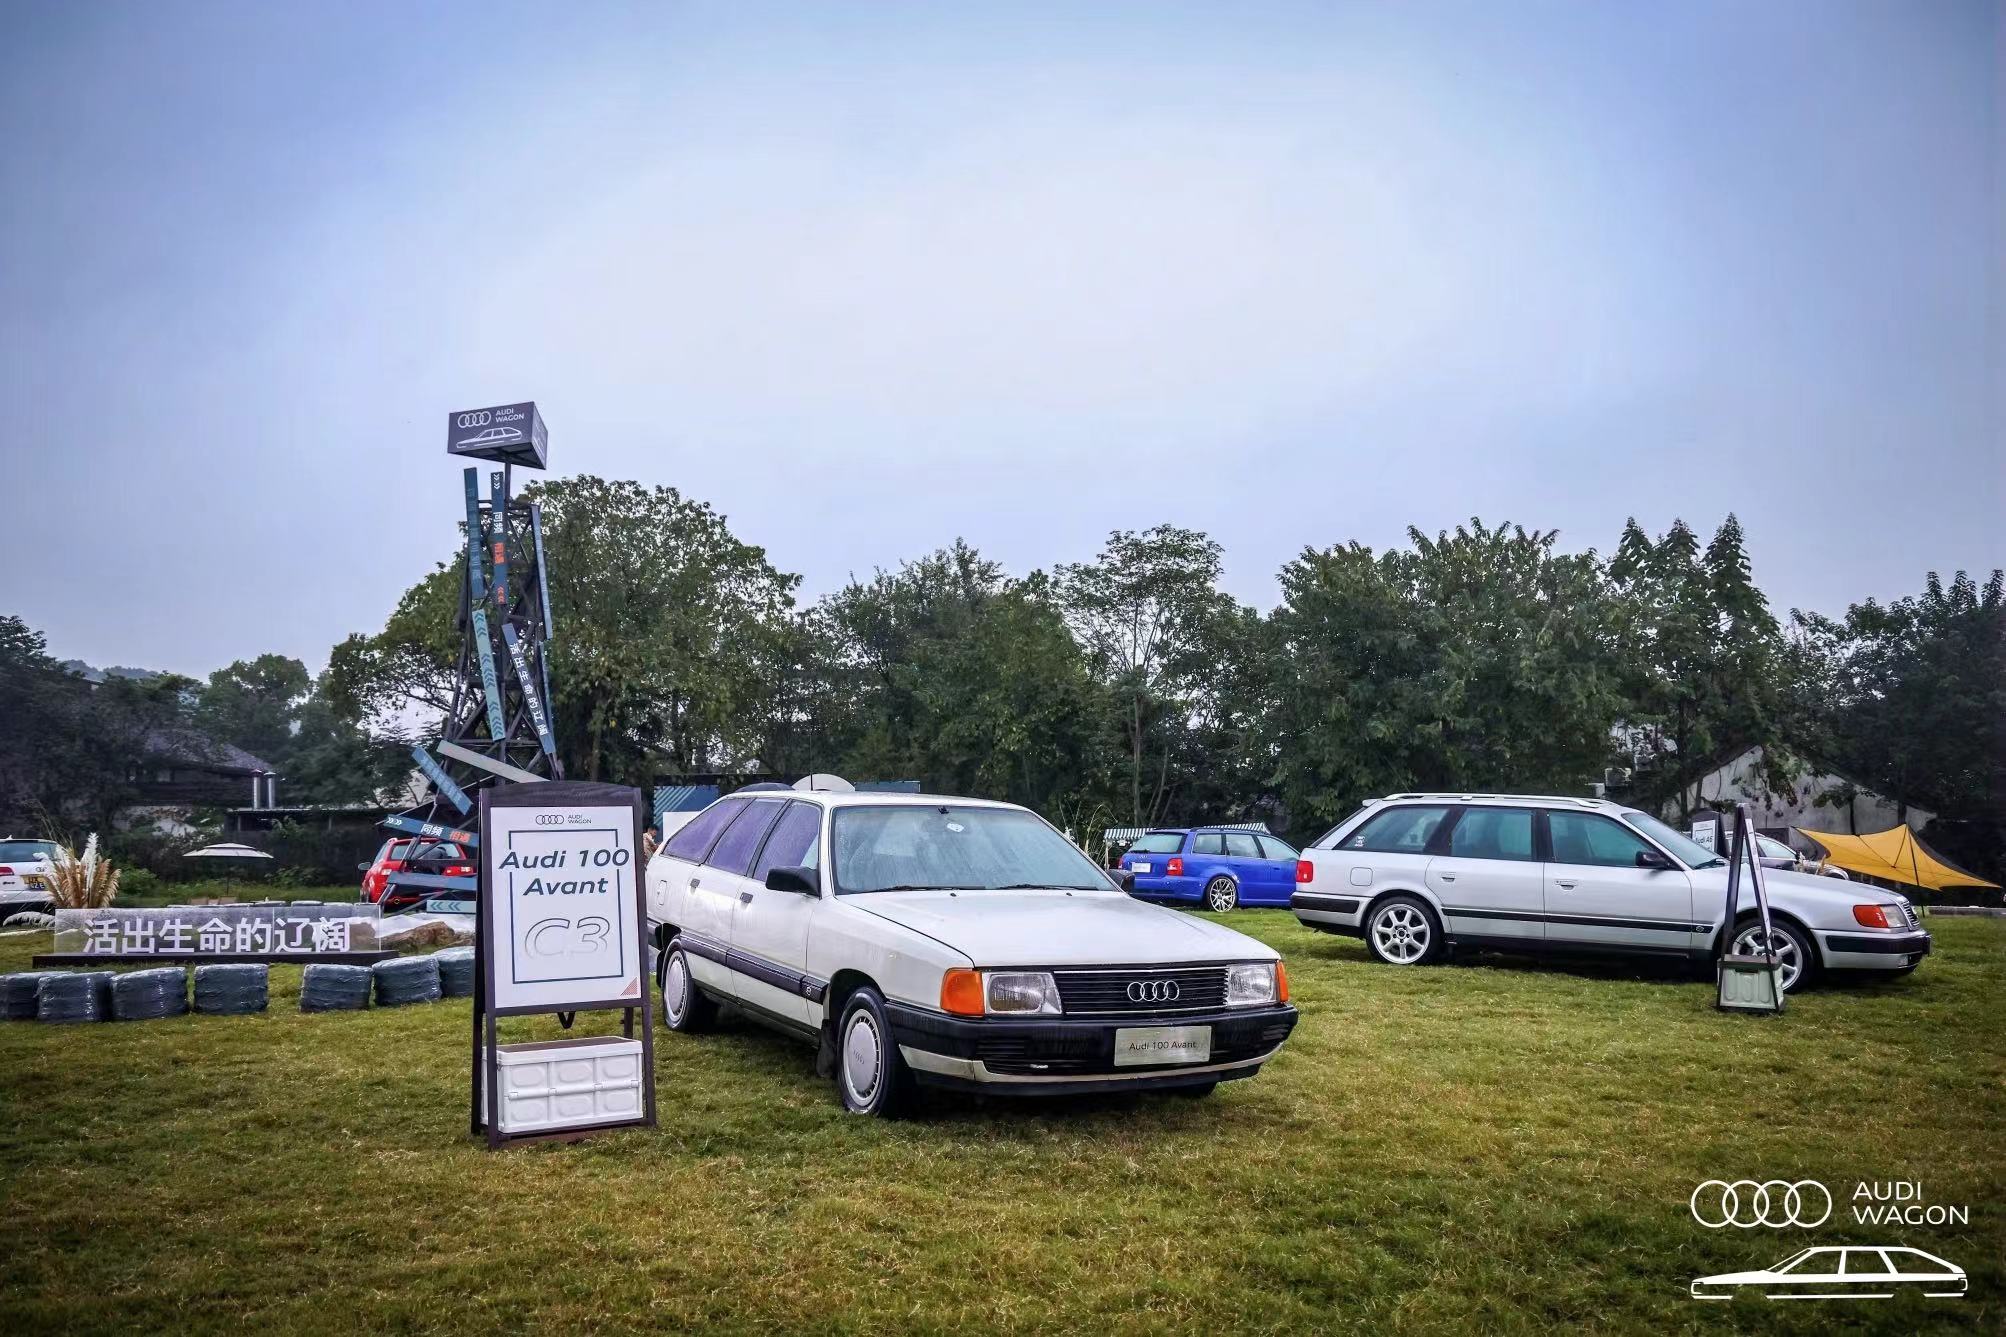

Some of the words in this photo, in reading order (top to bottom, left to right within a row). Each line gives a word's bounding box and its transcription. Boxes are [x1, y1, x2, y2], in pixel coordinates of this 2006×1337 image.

[495, 407, 514, 416] AUDI
[495, 413, 525, 423] WAGON
[498, 850, 567, 869] Audi
[579, 849, 630, 867] 100
[523, 878, 608, 896] Avant
[83, 918, 350, 954] 活出生命的辽阔
[524, 916, 611, 959] C3
[1129, 1042, 1149, 1051] Audi
[1152, 1041, 1169, 1050] 100
[1170, 1041, 1197, 1049] Avant
